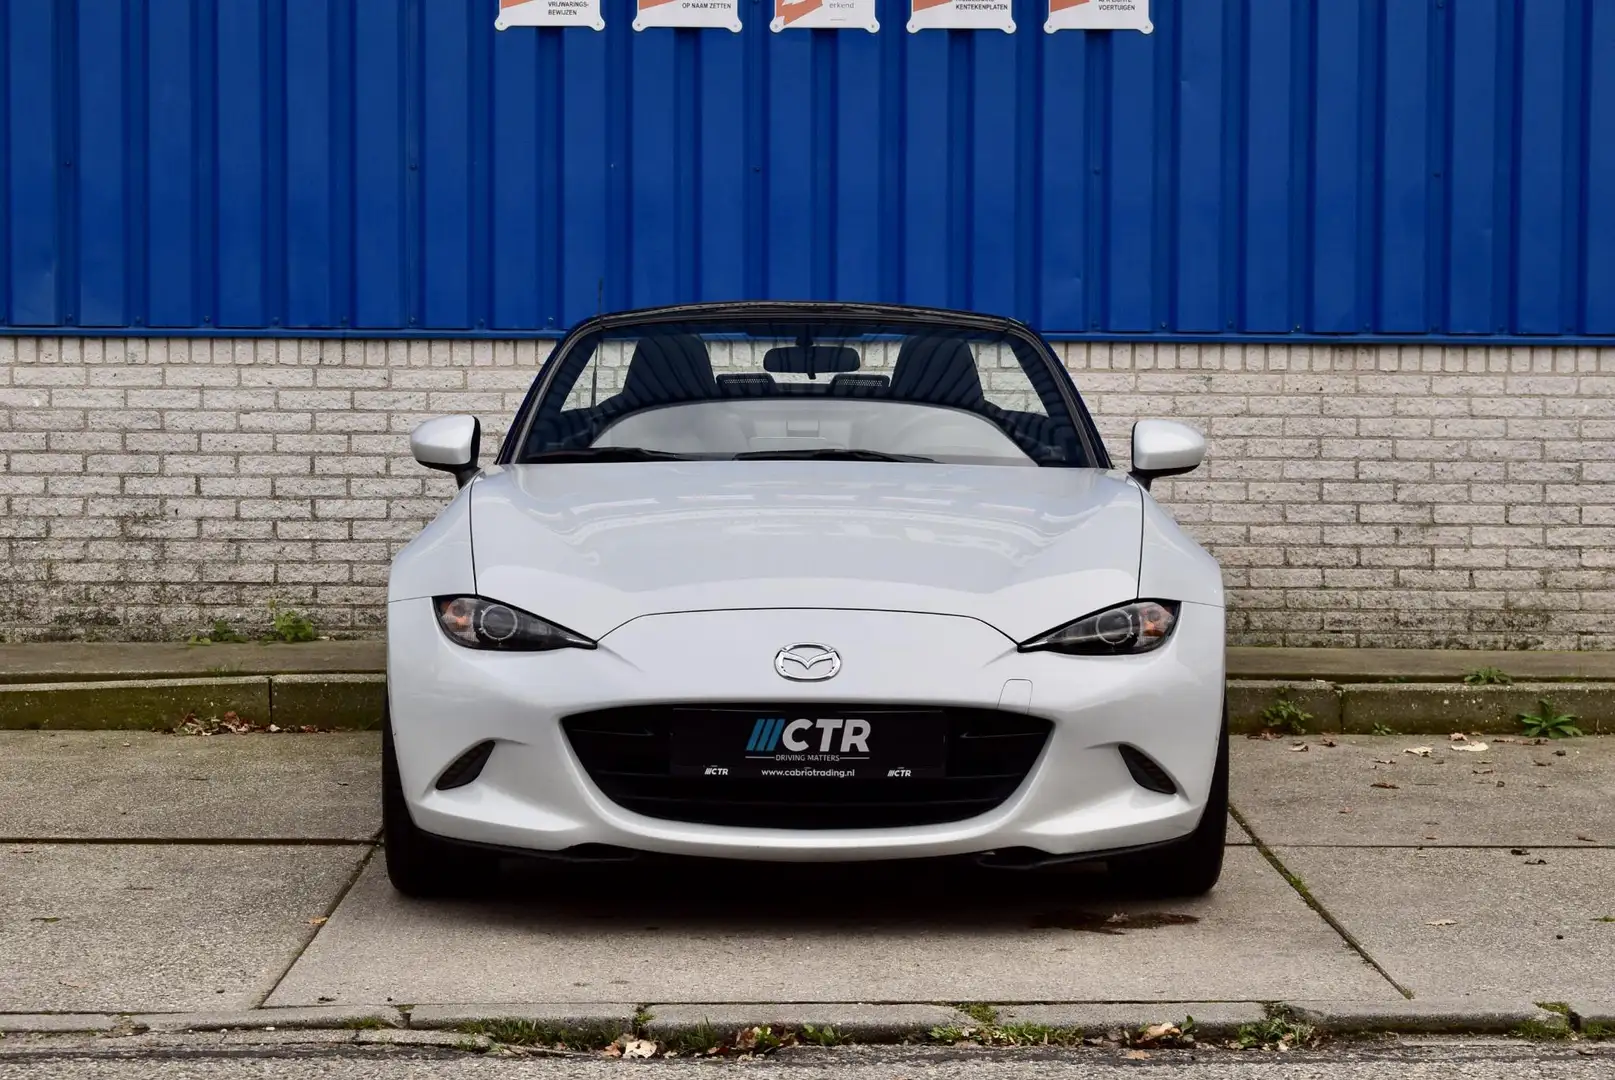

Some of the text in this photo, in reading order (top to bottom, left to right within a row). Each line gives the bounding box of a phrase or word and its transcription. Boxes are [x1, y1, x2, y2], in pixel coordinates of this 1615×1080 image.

[782, 718, 871, 752] CTR
[711, 767, 729, 776] CTR
[761, 768, 855, 778] www.cabriotrading.nl
[893, 769, 912, 777] CTR
